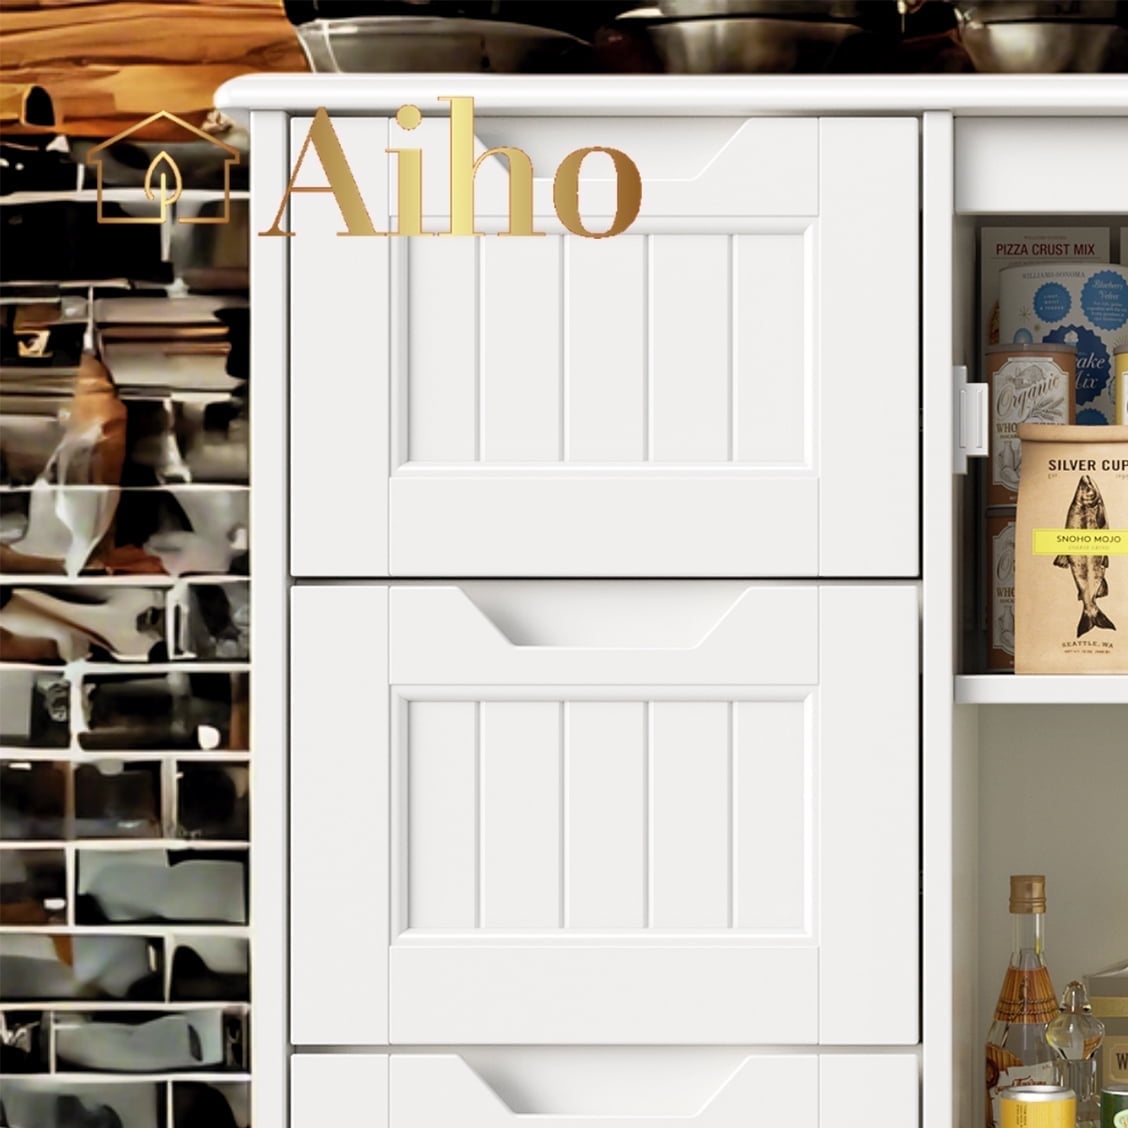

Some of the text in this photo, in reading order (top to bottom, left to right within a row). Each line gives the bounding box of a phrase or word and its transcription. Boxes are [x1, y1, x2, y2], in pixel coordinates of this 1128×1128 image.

[996, 243, 1096, 256] PIZZA CRUST MIX
[996, 372, 1061, 419] Organic
[1048, 459, 1097, 472] SILVER
[1056, 534, 1122, 544] SNOHO MOJO
[1102, 641, 1114, 649] WA
